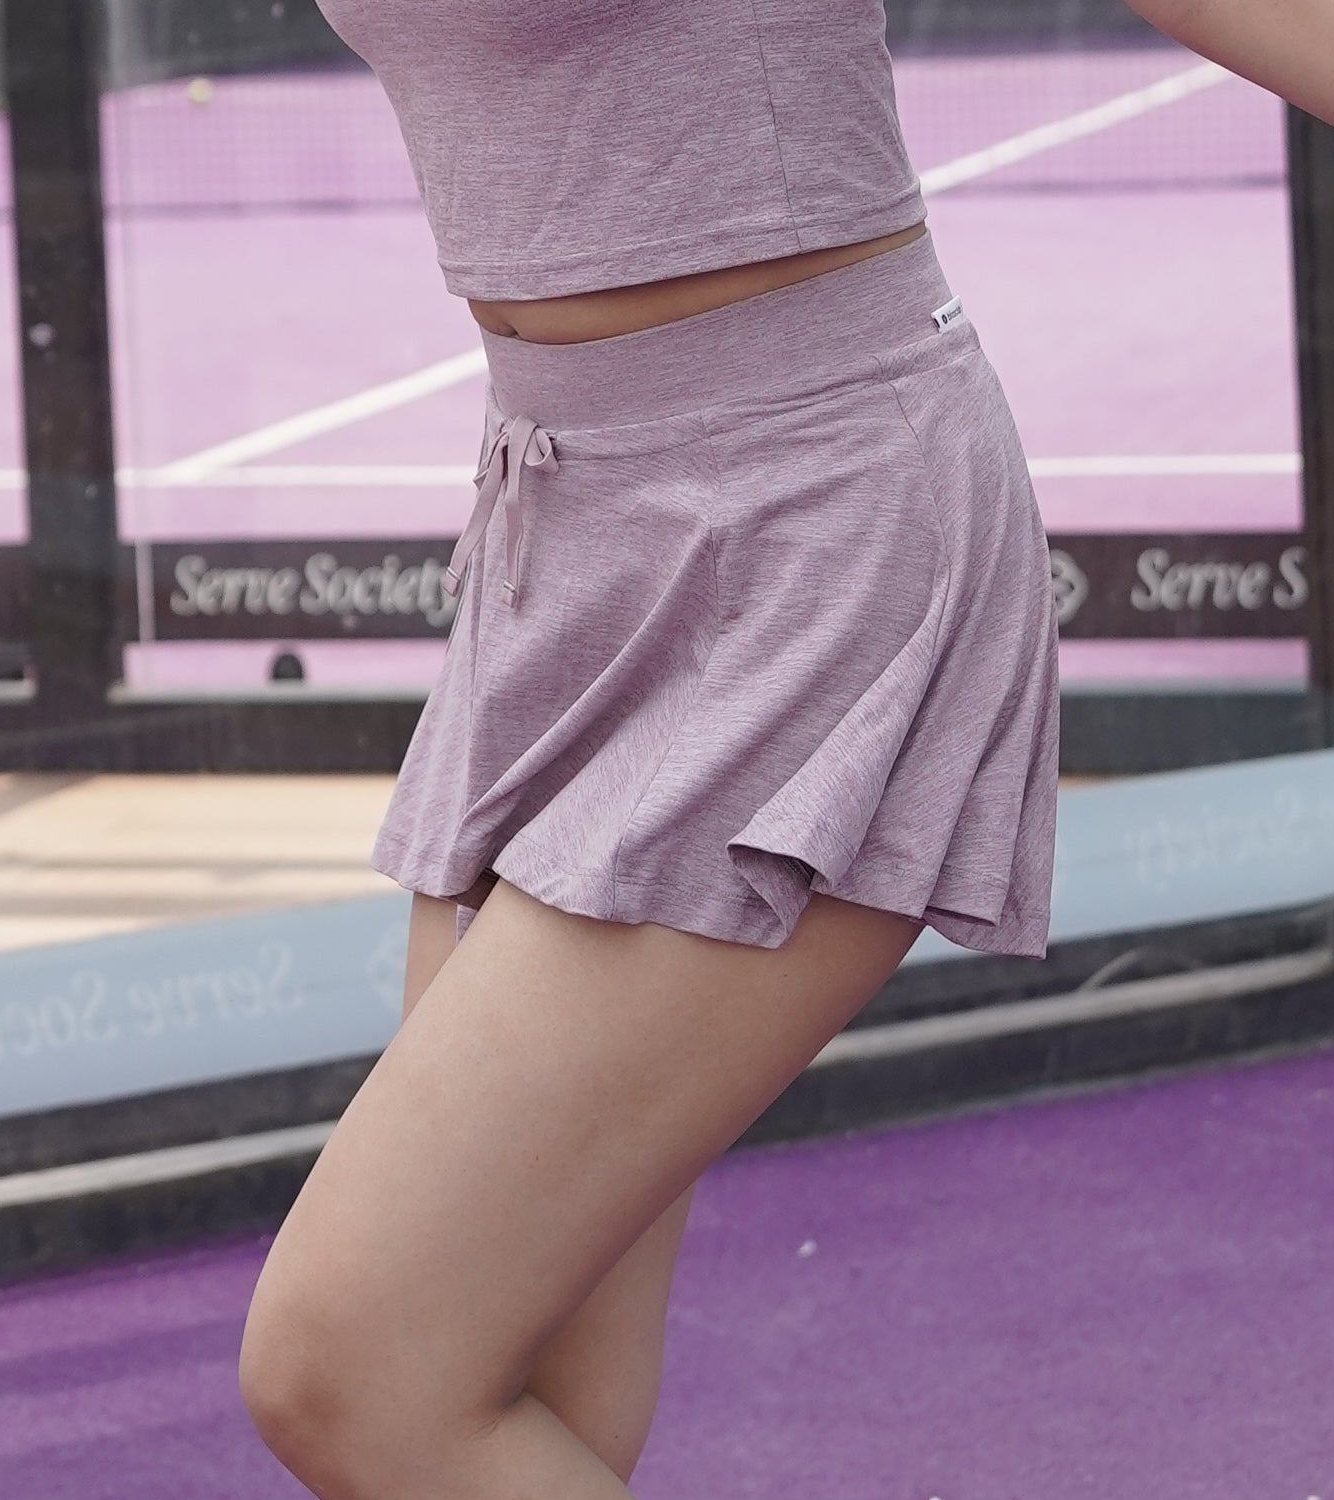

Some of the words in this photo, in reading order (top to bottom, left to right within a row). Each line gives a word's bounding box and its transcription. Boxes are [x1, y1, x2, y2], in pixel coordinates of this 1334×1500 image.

[170, 553, 302, 617] Serve
[299, 551, 460, 628] Society
[1131, 547, 1266, 613] Serve
